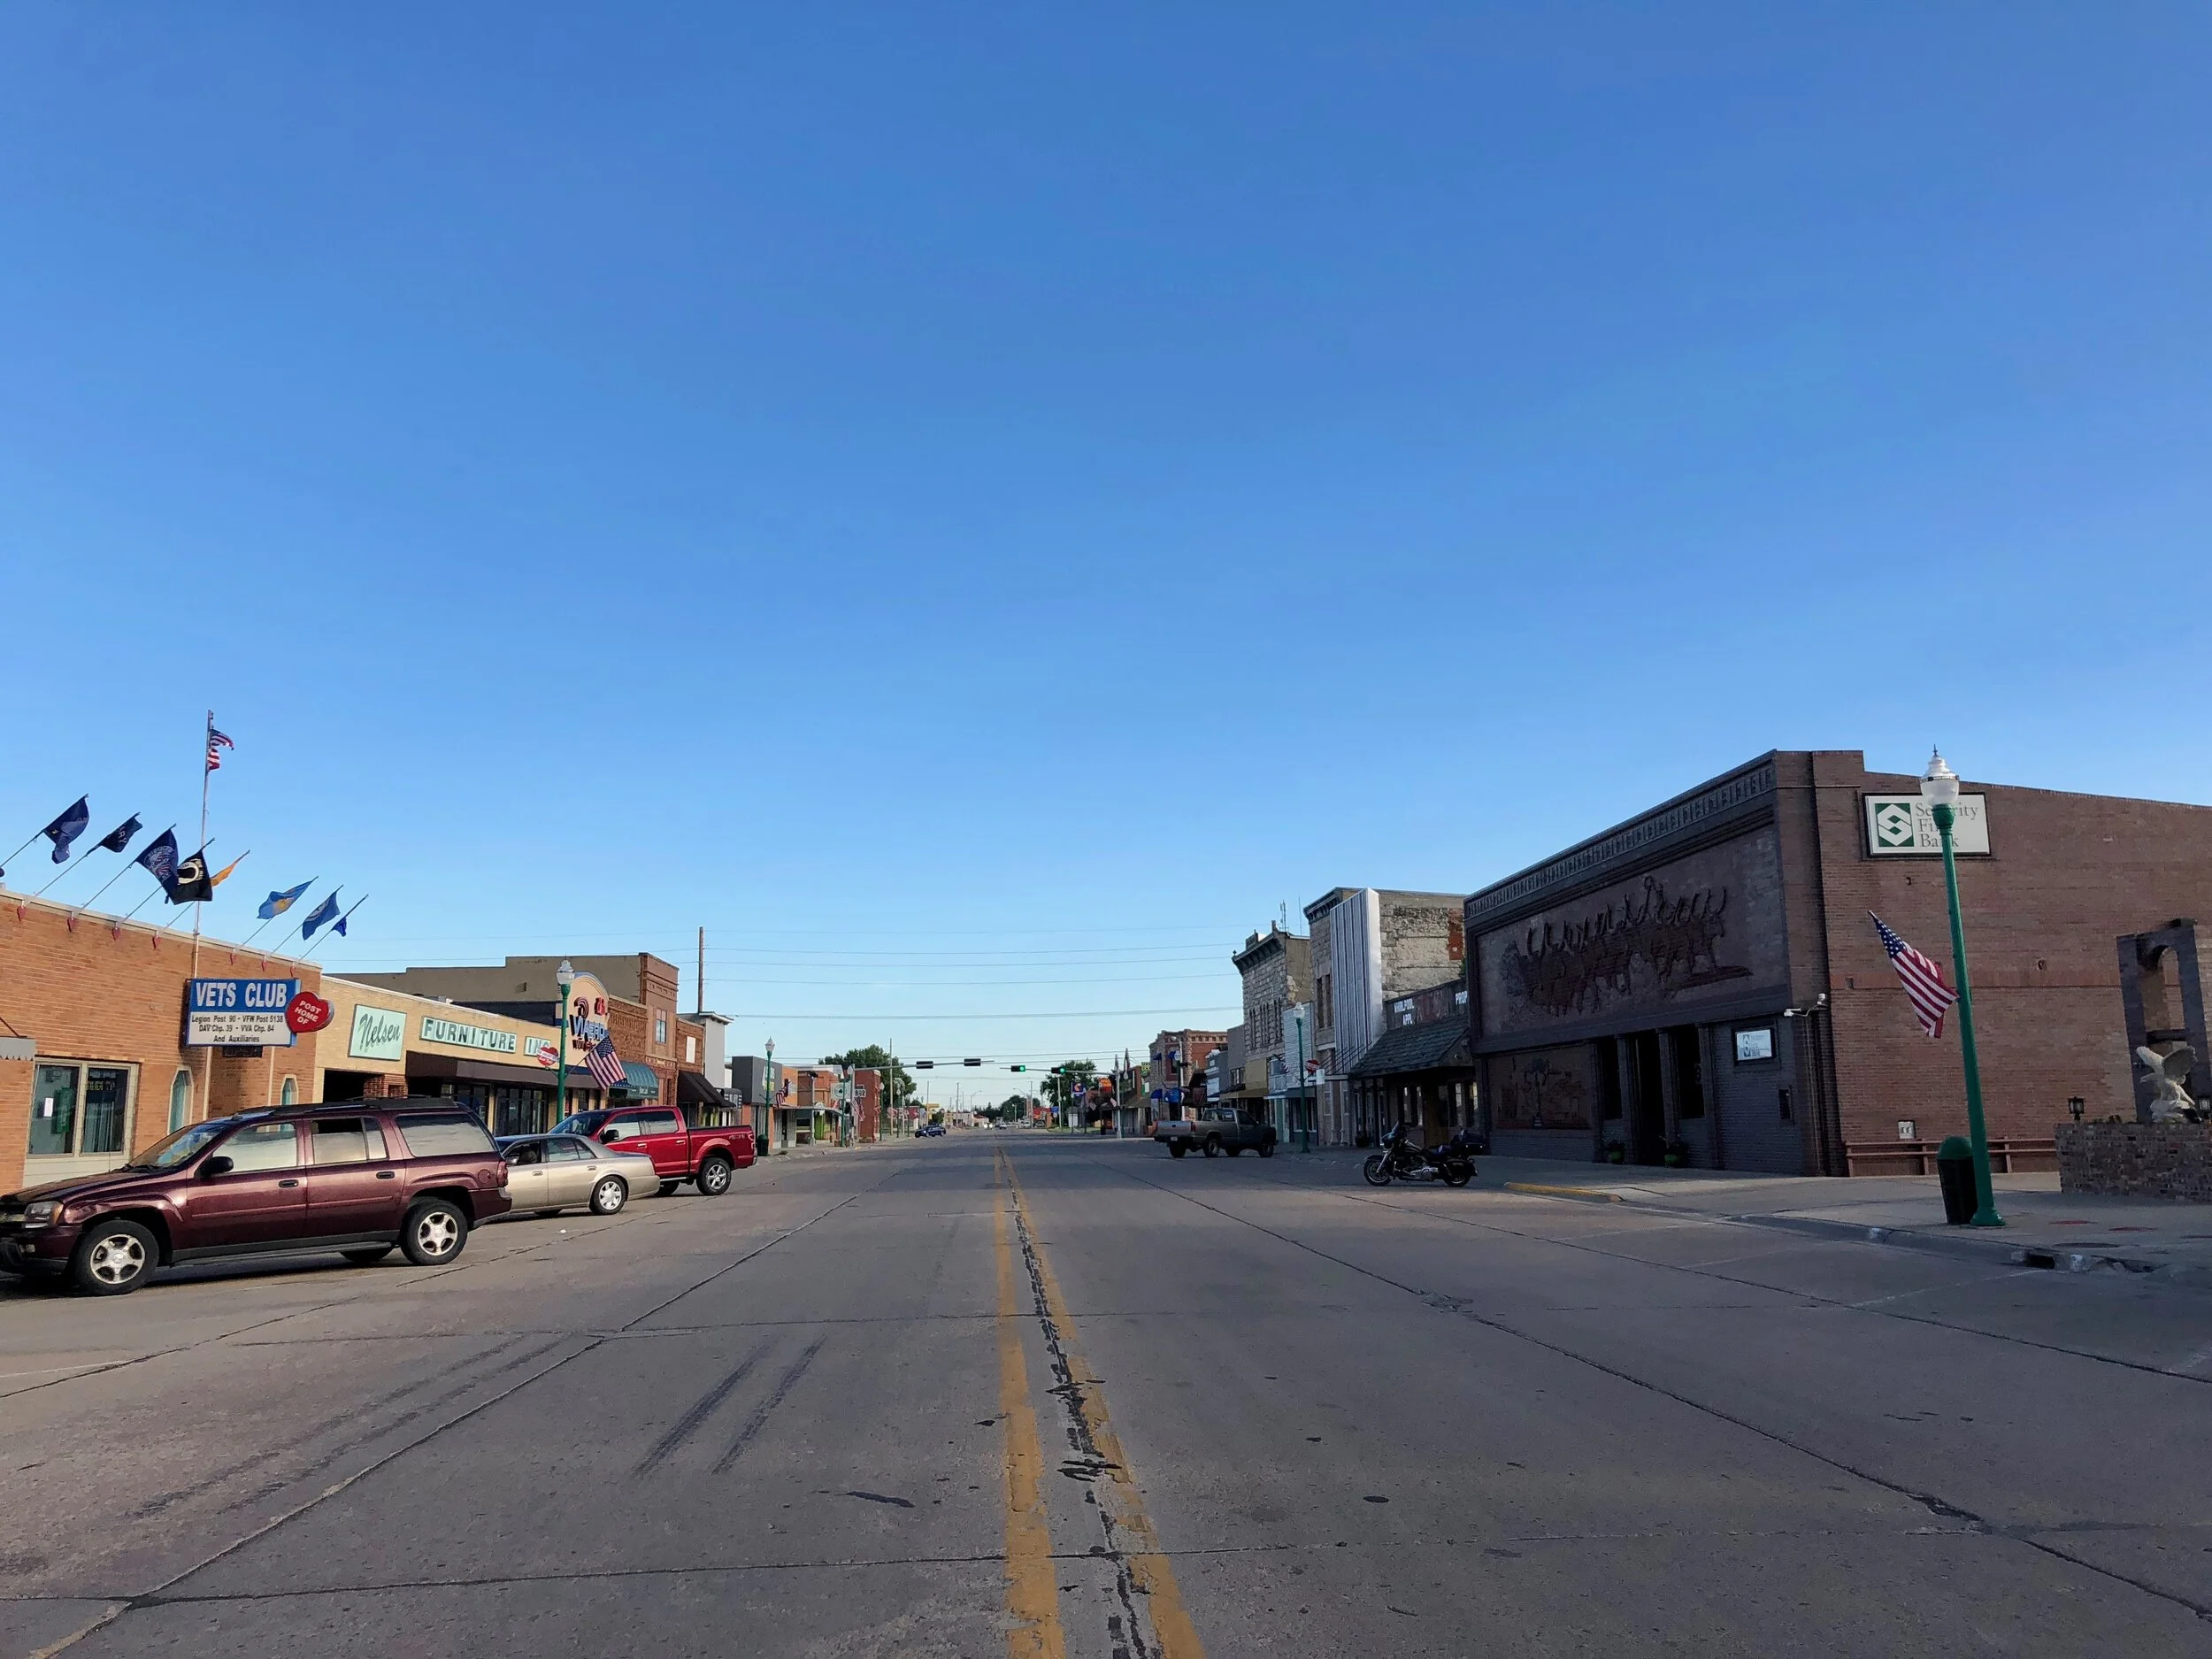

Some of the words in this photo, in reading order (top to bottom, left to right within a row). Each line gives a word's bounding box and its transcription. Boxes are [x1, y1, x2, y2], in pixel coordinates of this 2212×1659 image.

[1916, 802, 1978, 820] Serity
[1919, 833, 1959, 847] Bak
[196, 982, 236, 1007] VETS
[245, 982, 287, 1008] CLUB
[294, 1007, 319, 1022] HOME
[299, 1000, 322, 1014] POST
[191, 1015, 211, 1024] Legion
[296, 1016, 310, 1025] OF
[358, 1013, 400, 1048] Nelsen
[423, 1018, 515, 1050] FURNITURE
